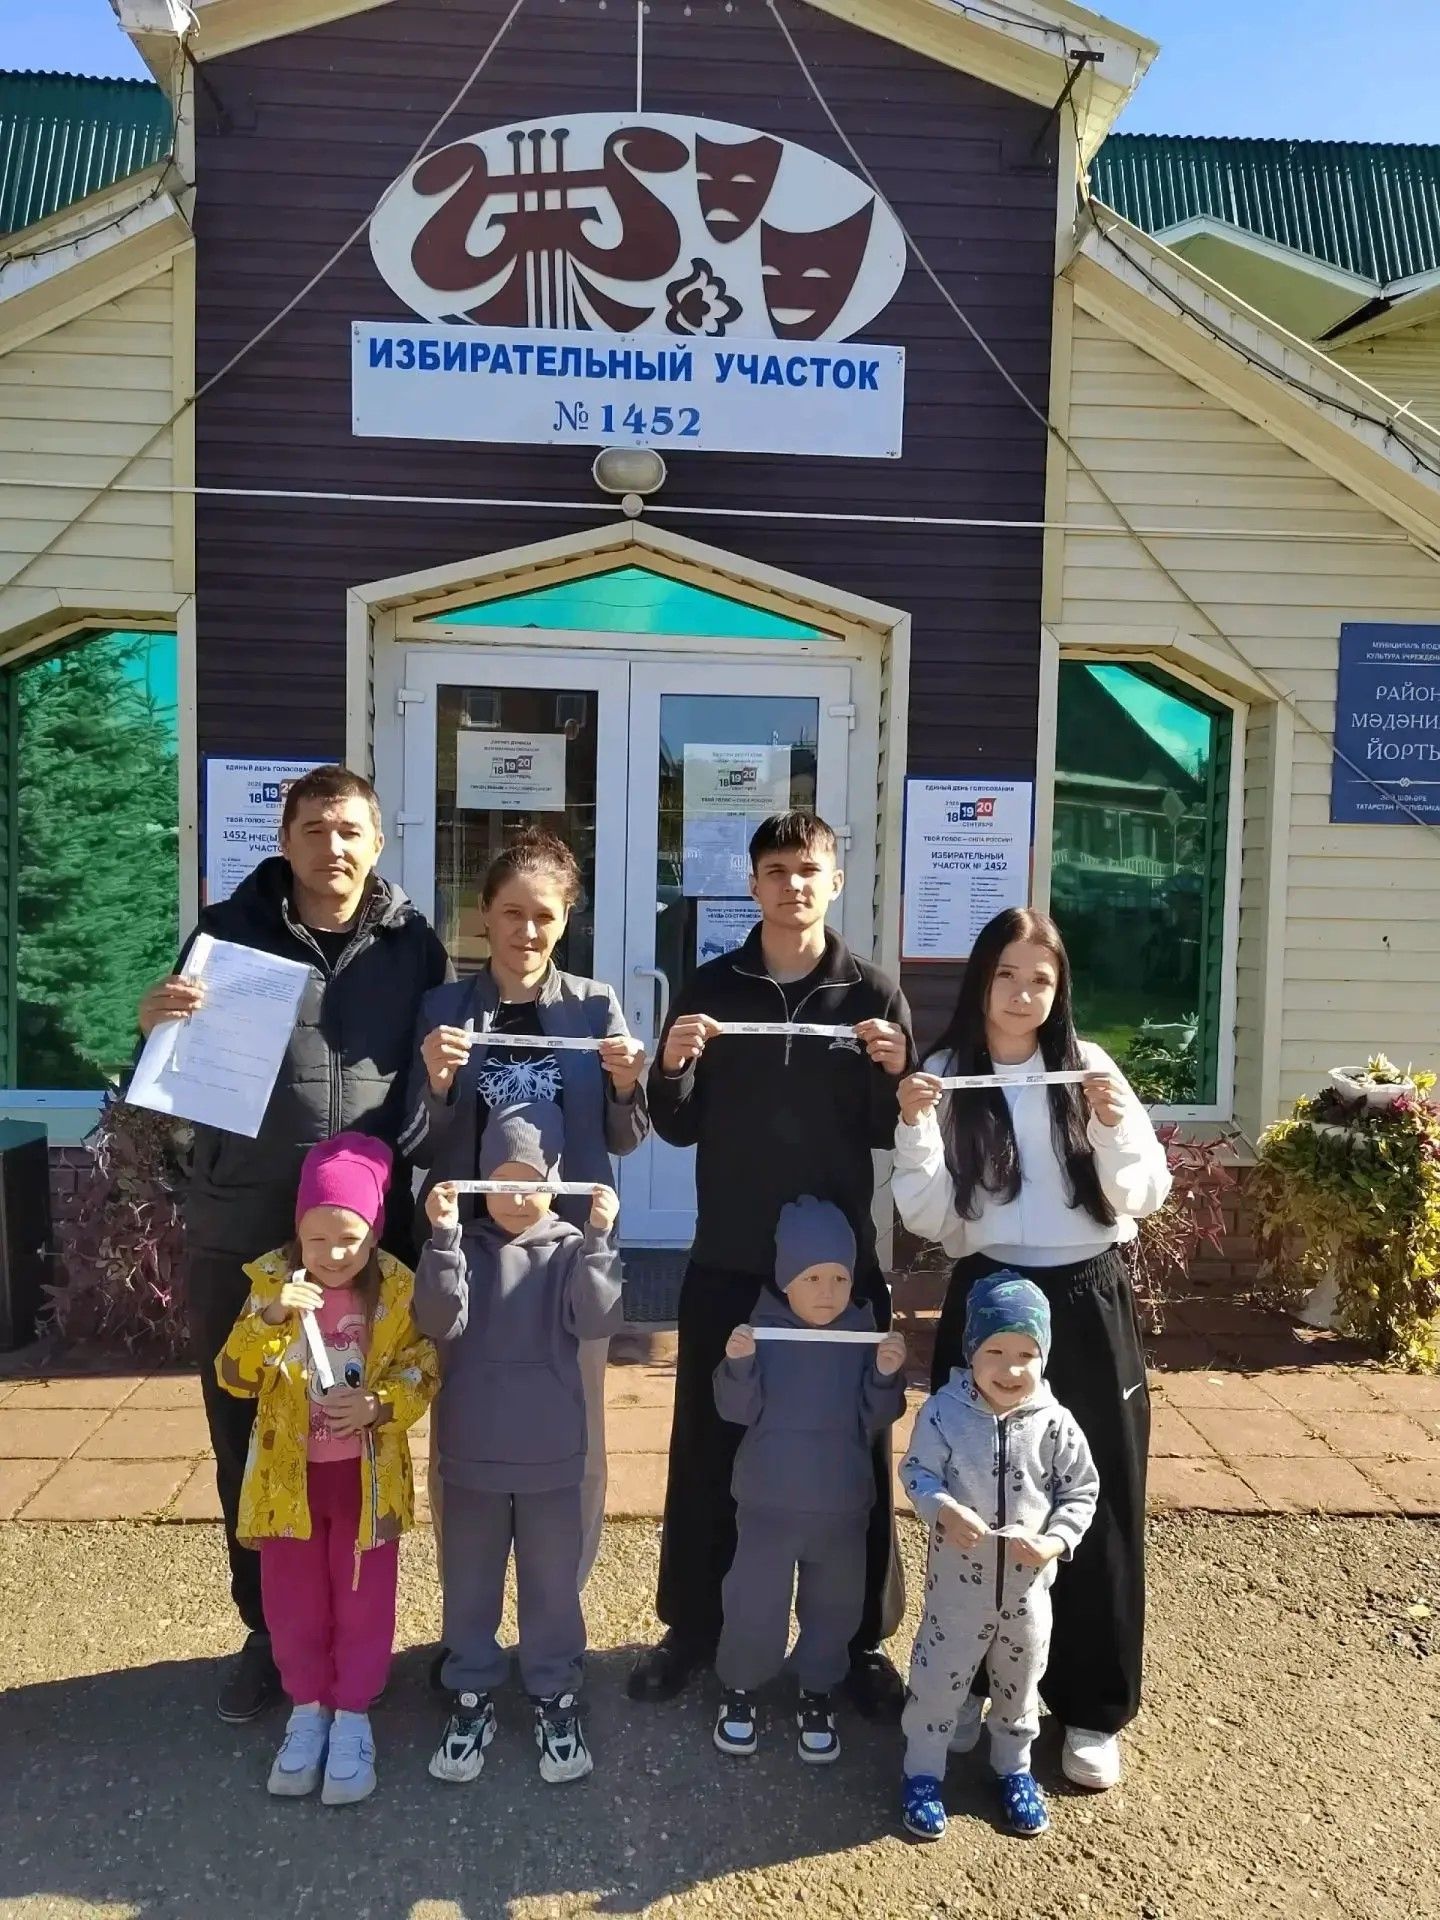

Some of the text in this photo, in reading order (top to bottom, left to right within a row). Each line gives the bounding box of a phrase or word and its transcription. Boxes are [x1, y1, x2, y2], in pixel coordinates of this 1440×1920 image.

[369, 337, 880, 391] ИЗБИРАТЕЛЬНЫЙ УЧАСТОК
[553, 401, 701, 437] № 1452
[1366, 652, 1400, 660] КУЛЬТУРА
[1351, 712, 1440, 731] МӘДӘНИ
[505, 761, 516, 771] 19
[249, 793, 262, 804] 18
[264, 787, 278, 799] 19
[946, 802, 993, 822] 18 19 20
[223, 830, 247, 840] 1452
[932, 862, 970, 870] УЧАСТОК
[983, 862, 1008, 871] 1452
